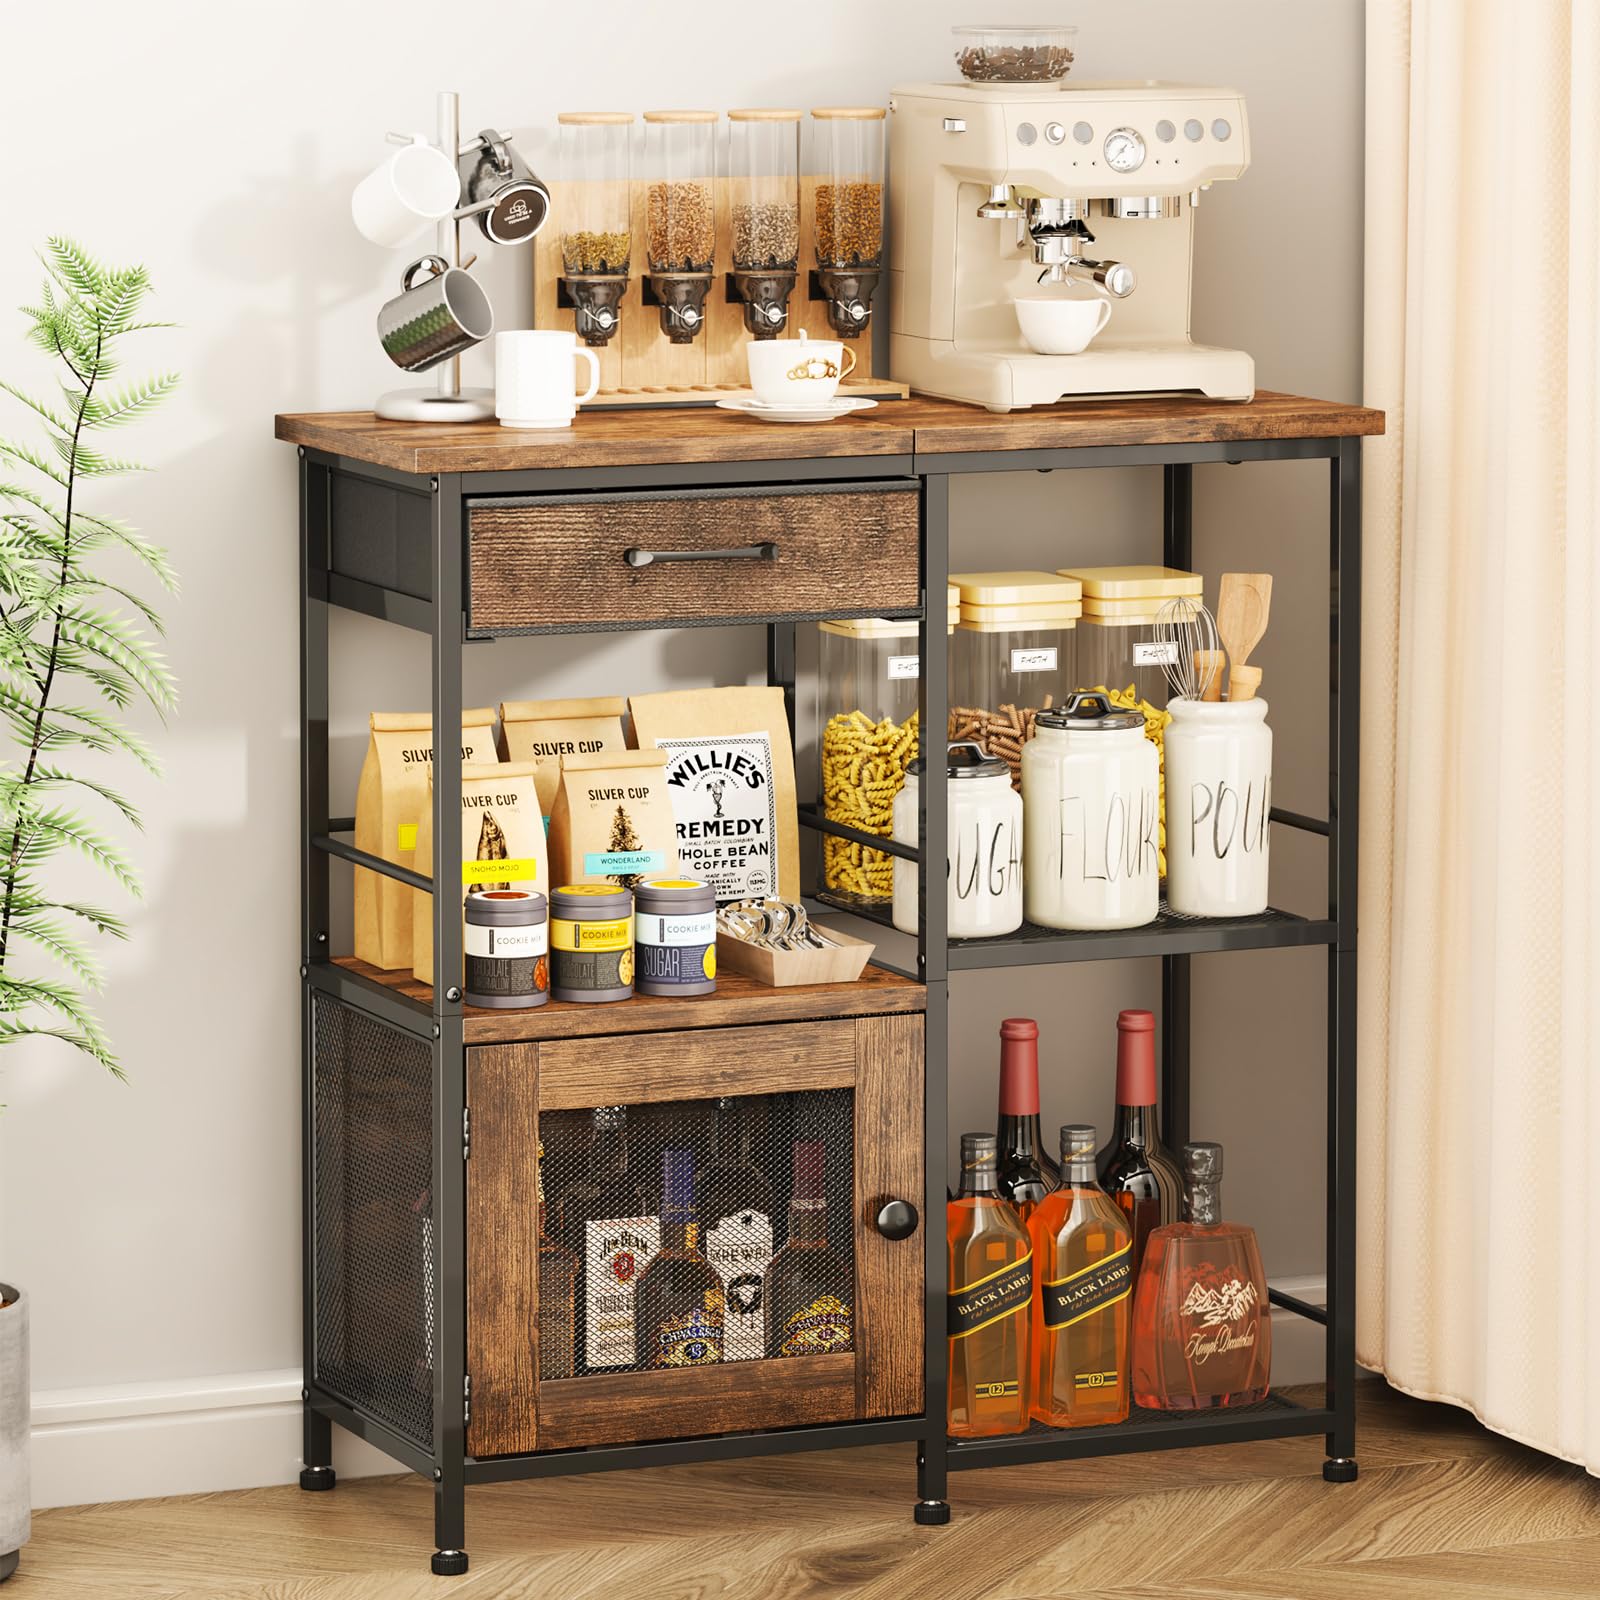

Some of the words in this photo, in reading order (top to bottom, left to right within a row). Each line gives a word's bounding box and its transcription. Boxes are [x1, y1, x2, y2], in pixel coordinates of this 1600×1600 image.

[532, 742, 575, 756] SILVER
[578, 740, 604, 753] CUP
[402, 749, 433, 763] SILVE
[667, 750, 765, 789] WILLIE'S
[462, 795, 493, 808] ILVER
[496, 793, 518, 806] CUP
[588, 788, 625, 801] SILVER
[628, 787, 650, 799] CUP
[1191, 774, 1271, 859] POU
[1060, 786, 1159, 884] FLOUR
[678, 848, 722, 860] HOLE
[728, 840, 769, 856] BEAN
[600, 856, 651, 865] WONDERLAND
[693, 859, 746, 870] COFFEE
[470, 865, 498, 874] SNOHO
[498, 864, 520, 872] MOJO
[582, 931, 614, 939] COOKIE
[667, 924, 699, 934] COOKIE
[496, 936, 529, 945] COOKIE
[643, 946, 680, 977] SUGAR
[1057, 1282, 1098, 1306] BLACK
[957, 1291, 998, 1315] BLACK
[1092, 1375, 1102, 1384] 12
[991, 1385, 1002, 1393] 12
